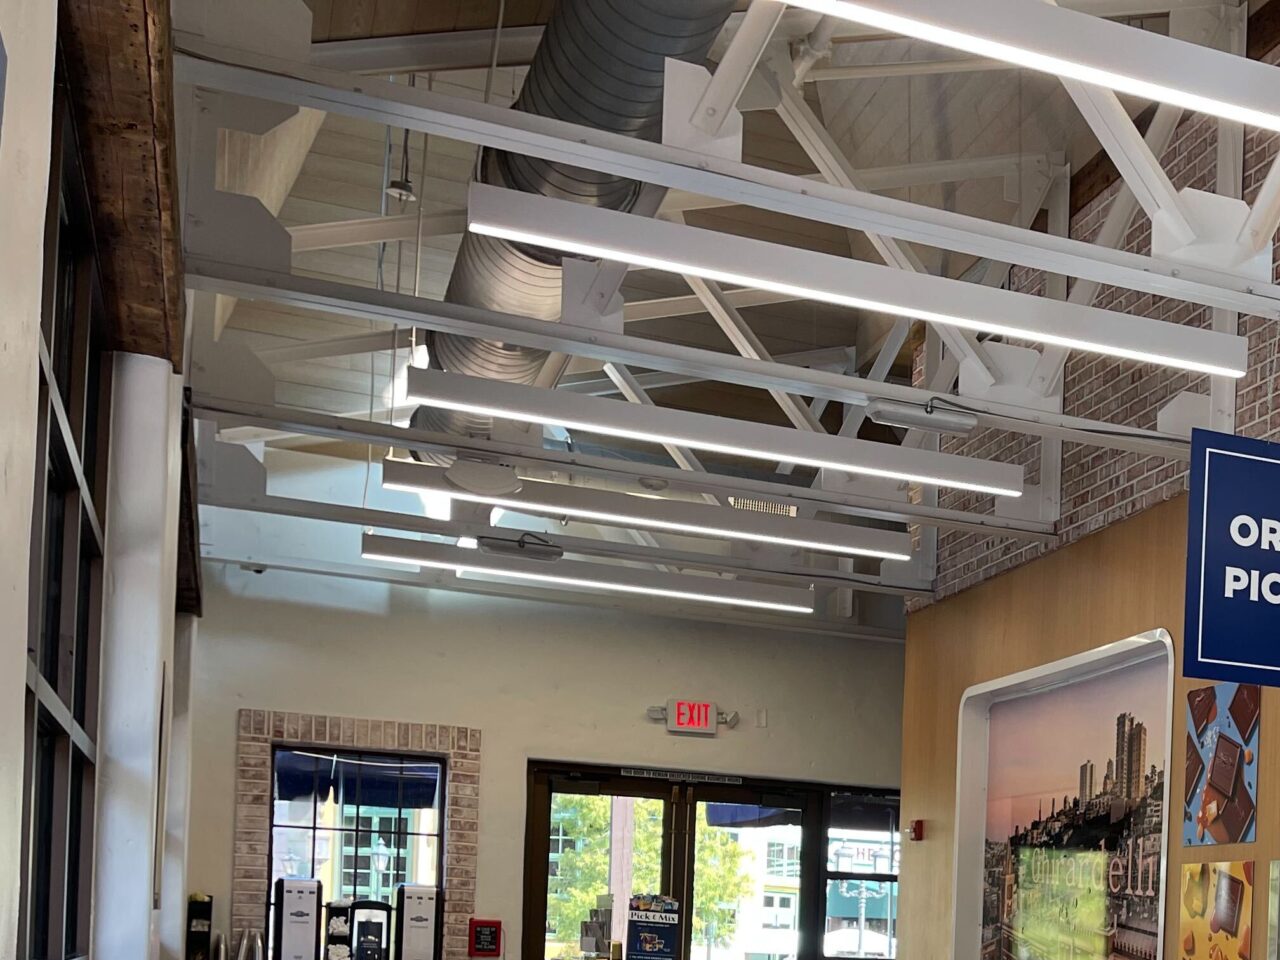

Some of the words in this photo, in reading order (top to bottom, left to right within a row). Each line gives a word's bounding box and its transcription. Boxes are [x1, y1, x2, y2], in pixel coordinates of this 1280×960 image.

[676, 701, 711, 729] EXIT
[630, 911, 651, 921] Pick
[659, 913, 676, 923] Mix
